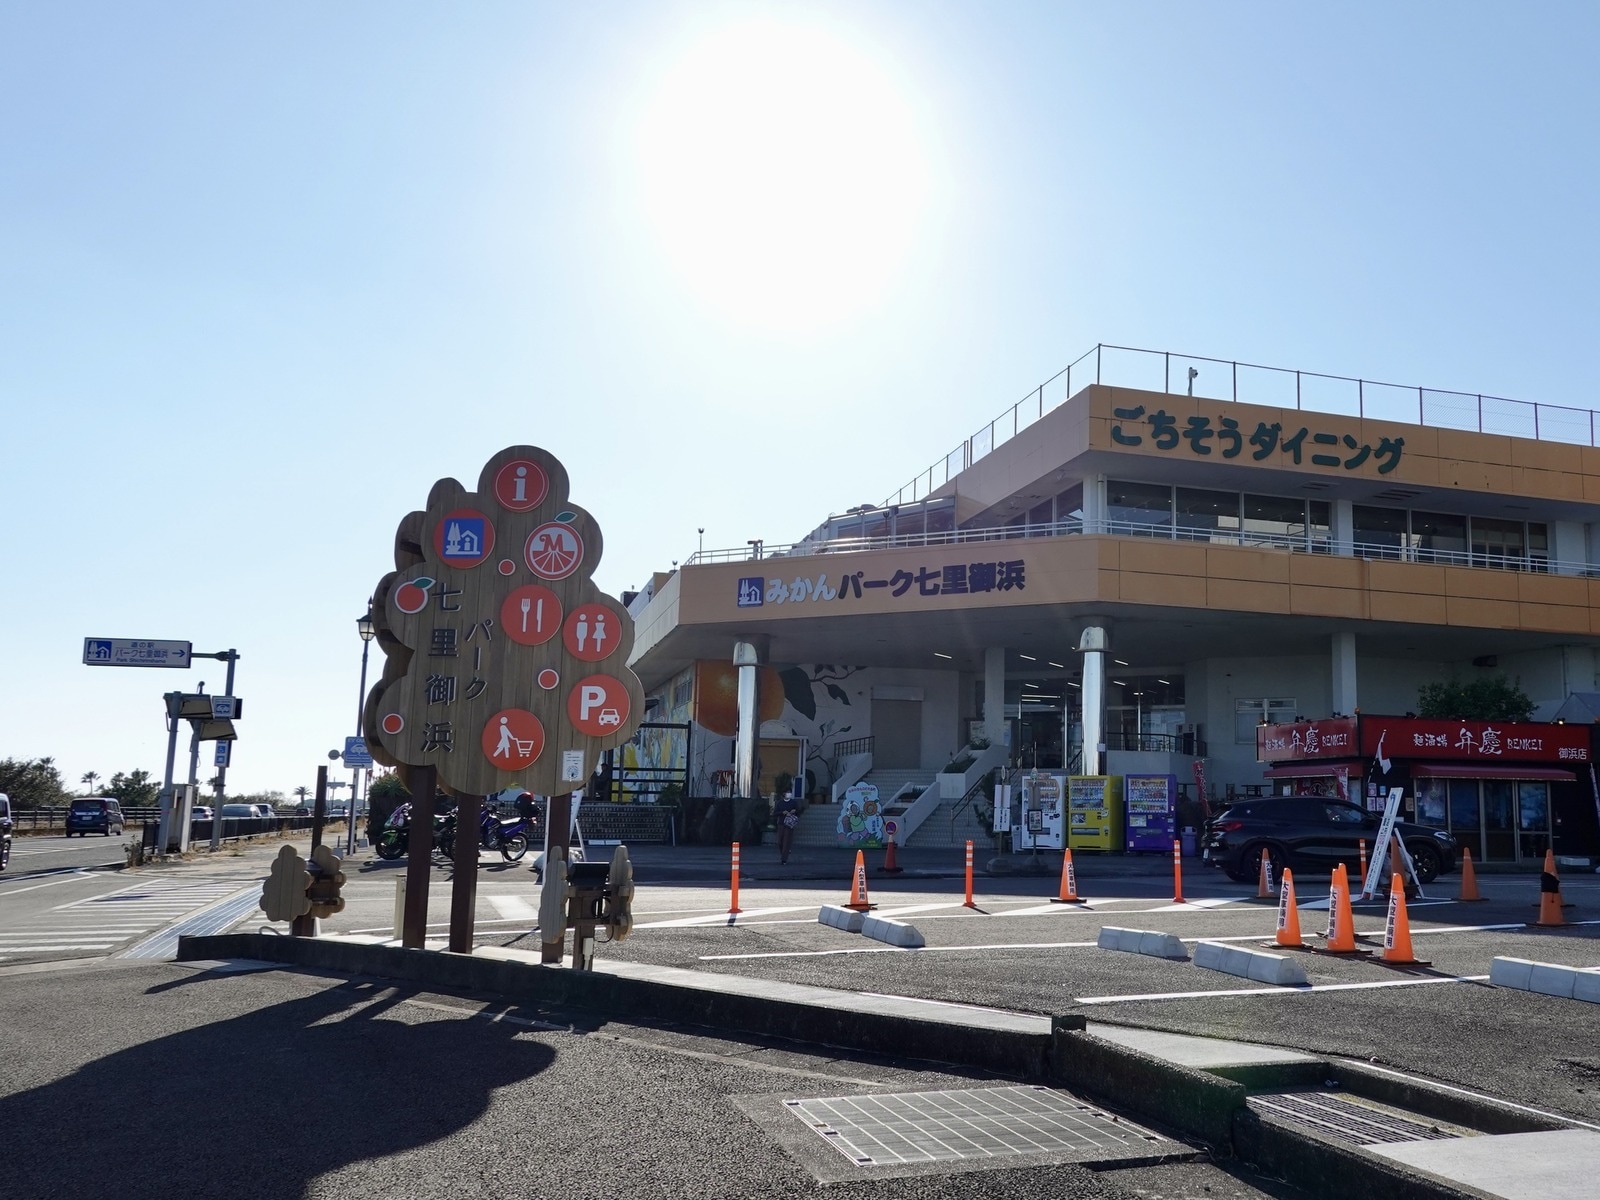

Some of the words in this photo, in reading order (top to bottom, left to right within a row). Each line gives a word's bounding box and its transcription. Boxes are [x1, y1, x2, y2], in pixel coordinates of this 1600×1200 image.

[1111, 405, 1405, 475] ごちそうダイニング
[765, 559, 1026, 605] みかんパーク七里御浜
[421, 582, 463, 754] 七里御浜
[465, 618, 494, 701] パーク
[580, 685, 607, 721] P
[1289, 726, 1319, 755] 弁慶
[1322, 734, 1348, 747] BENKEI
[1454, 726, 1502, 755] 弁慶
[1507, 738, 1543, 750] BENKEI
[1558, 748, 1587, 760] 御浜店
